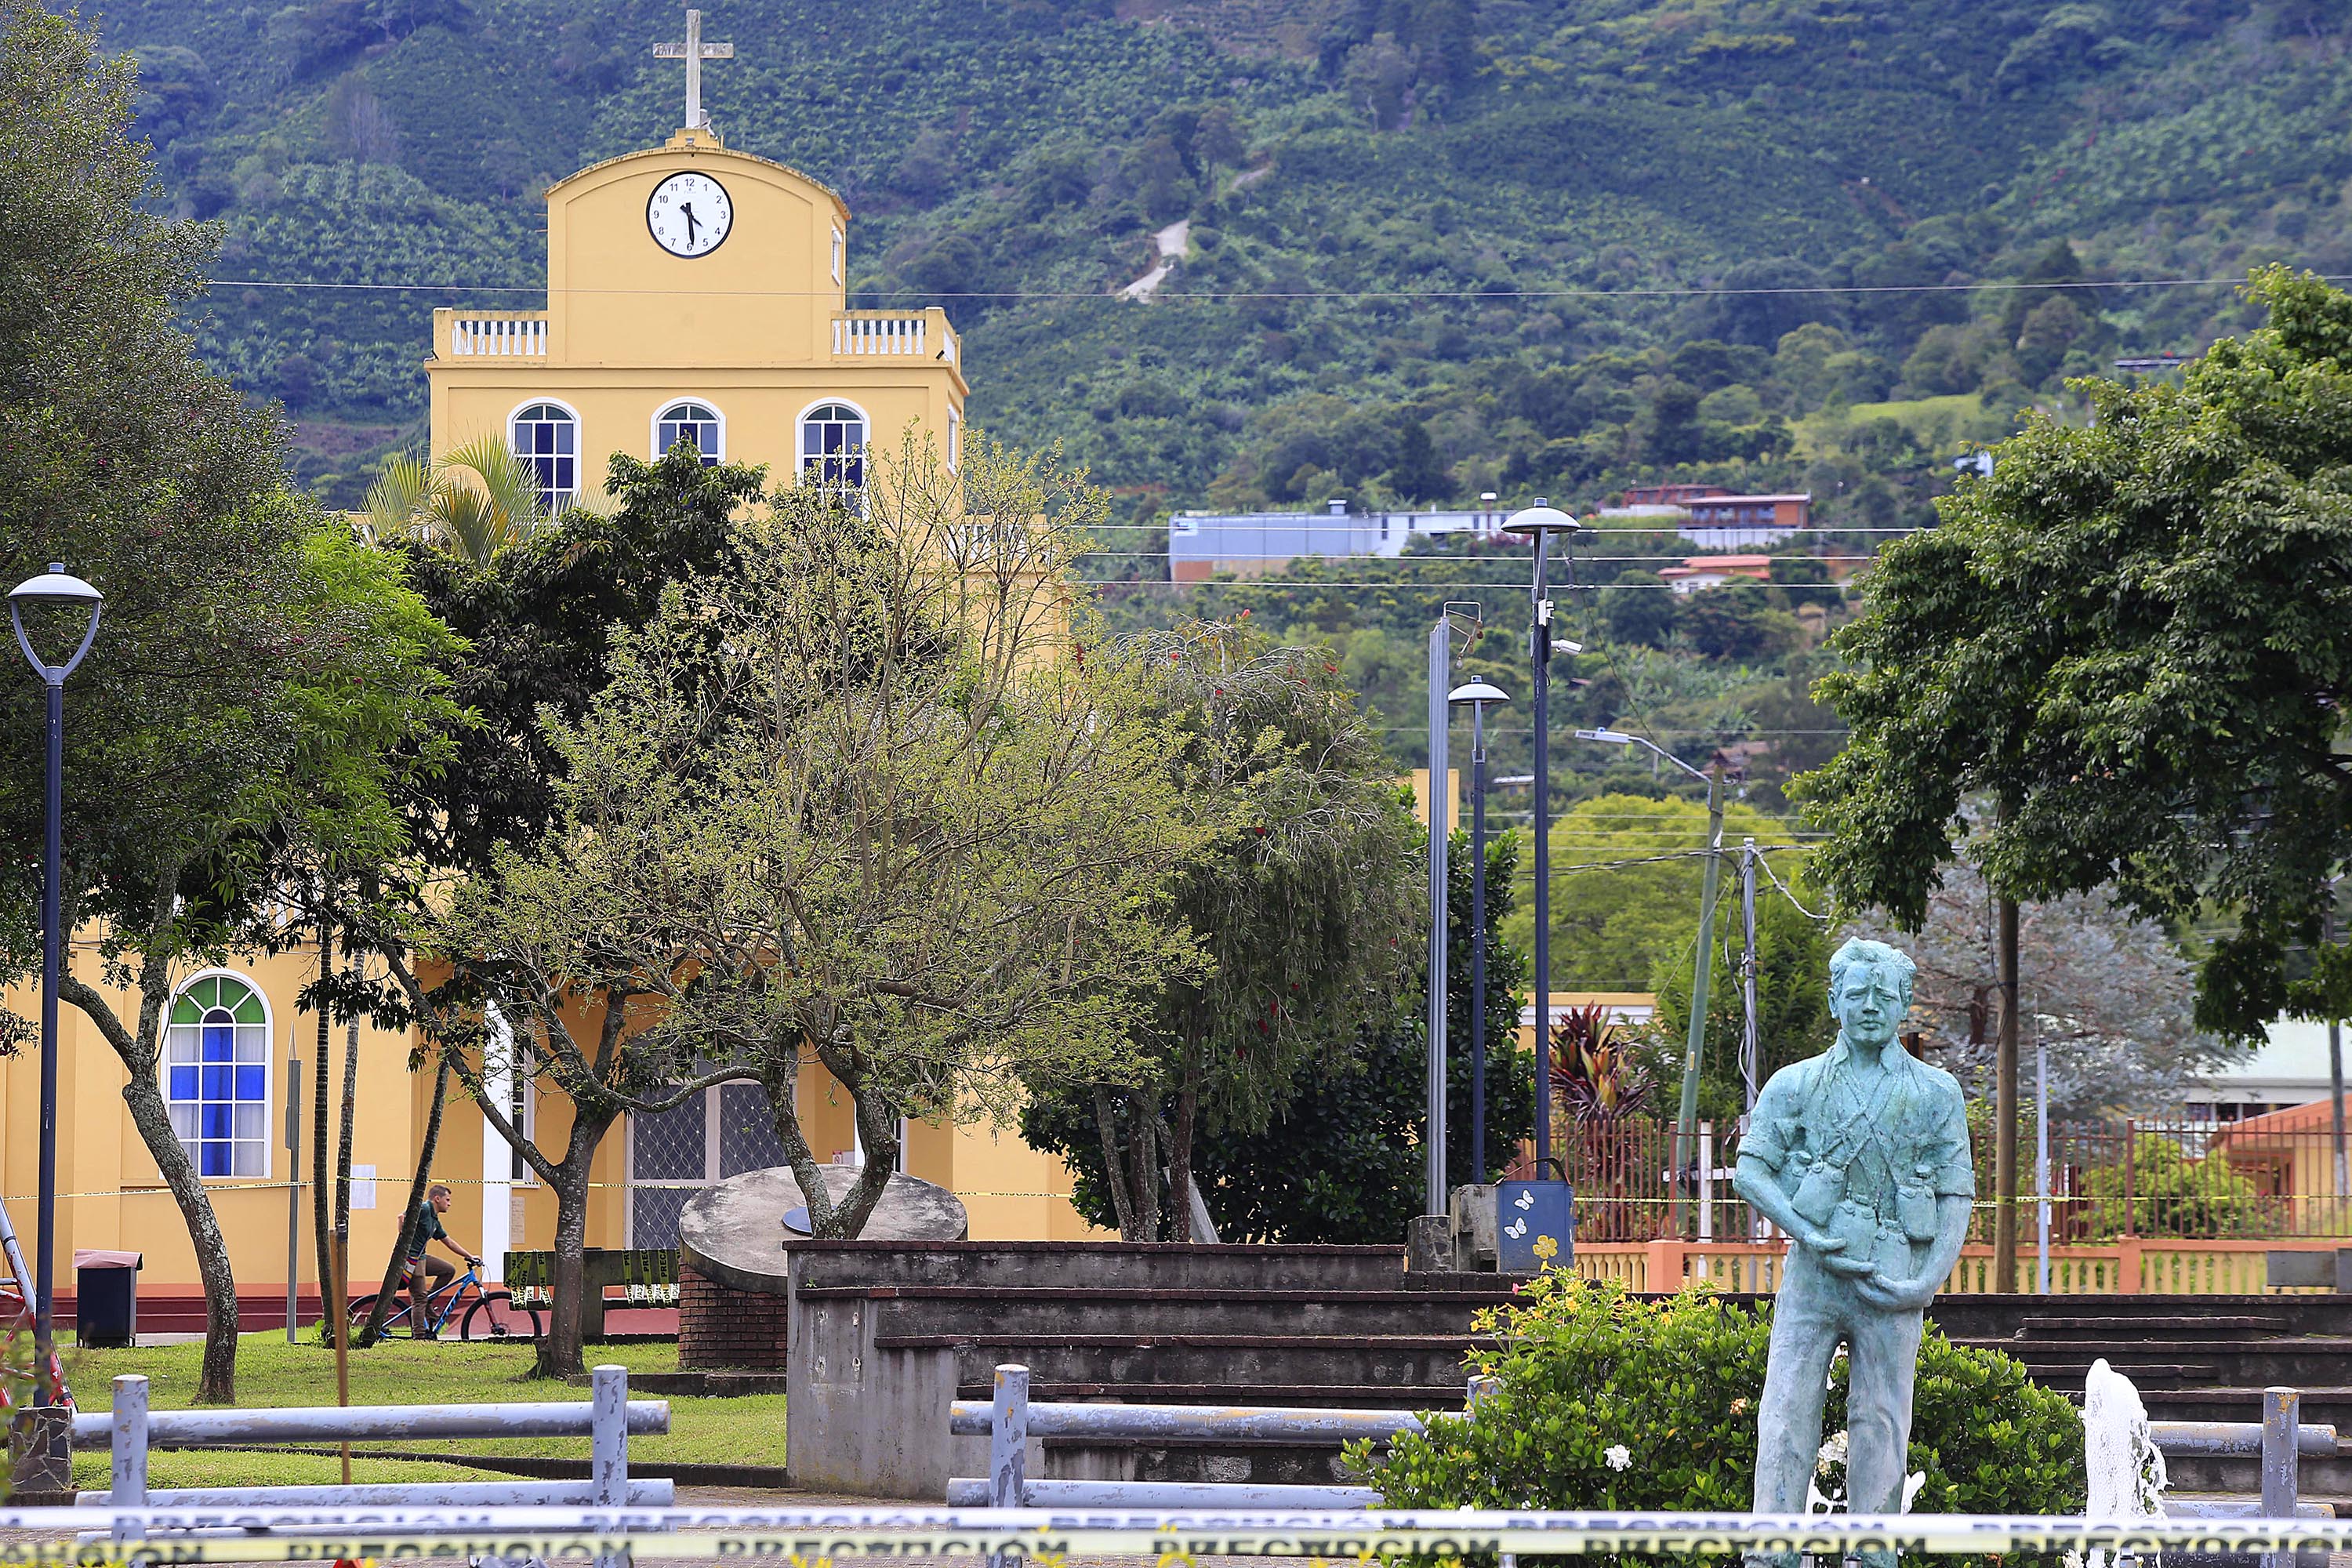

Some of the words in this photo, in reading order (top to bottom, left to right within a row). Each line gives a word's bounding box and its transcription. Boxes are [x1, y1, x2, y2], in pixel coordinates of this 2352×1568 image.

[684, 178, 695, 187] 12
[658, 195, 668, 204] 10
[716, 195, 722, 204] 2
[654, 210, 659, 219] 9
[659, 227, 664, 235] 8
